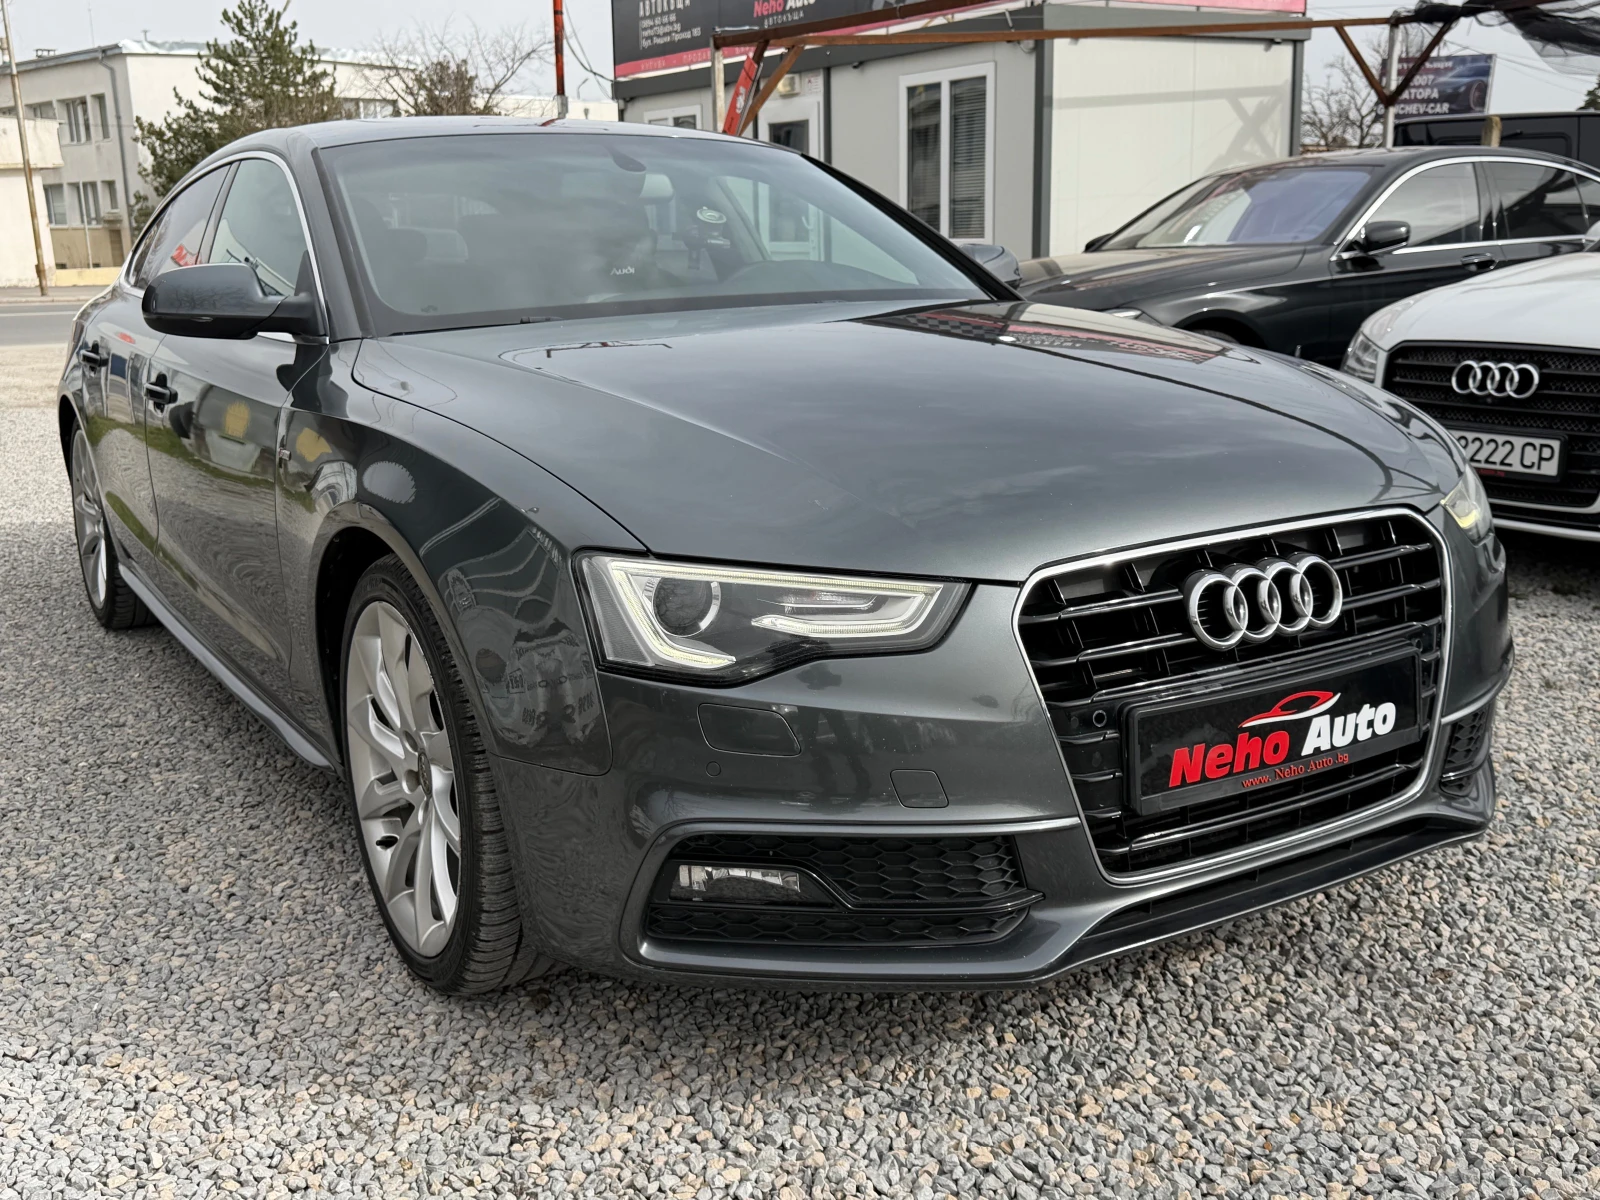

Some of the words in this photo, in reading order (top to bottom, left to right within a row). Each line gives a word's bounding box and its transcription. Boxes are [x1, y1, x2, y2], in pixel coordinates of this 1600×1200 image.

[753, 0, 785, 18] Neho
[764, 10, 805, 28] АВТОКЪЩА
[1377, 102, 1450, 115] GNCHEV-CAR
[610, 266, 635, 275] Audi
[1168, 730, 1290, 788] Neho
[1301, 702, 1396, 757] Auto
[1242, 774, 1272, 788] www.
[1274, 764, 1305, 781] Neho
[1307, 756, 1334, 773] Auto
